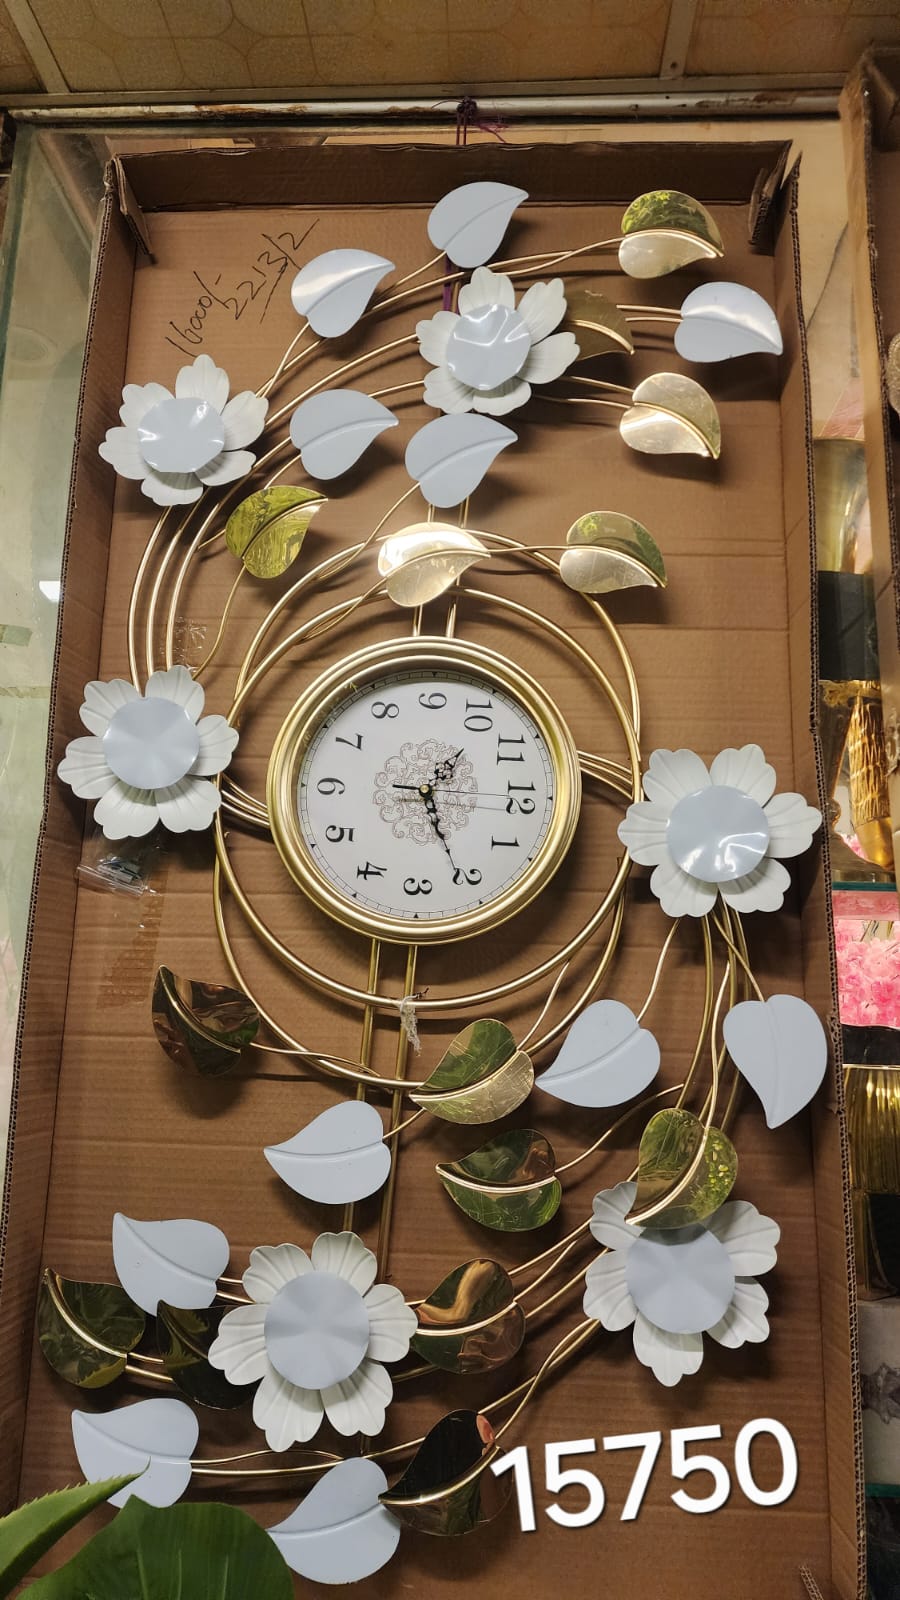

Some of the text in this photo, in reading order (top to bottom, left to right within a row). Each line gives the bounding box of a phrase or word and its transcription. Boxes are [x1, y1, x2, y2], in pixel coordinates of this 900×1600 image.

[371, 701, 399, 719] 8
[418, 692, 447, 710] 9
[464, 698, 493, 732] 10
[335, 733, 364, 751] 7
[496, 733, 526, 766] 11
[316, 777, 345, 795] 6
[505, 780, 537, 815] 12
[325, 824, 355, 843] 5
[490, 835, 520, 851] 1
[356, 861, 388, 881] 4
[452, 868, 483, 886] 2
[403, 877, 433, 896] 3
